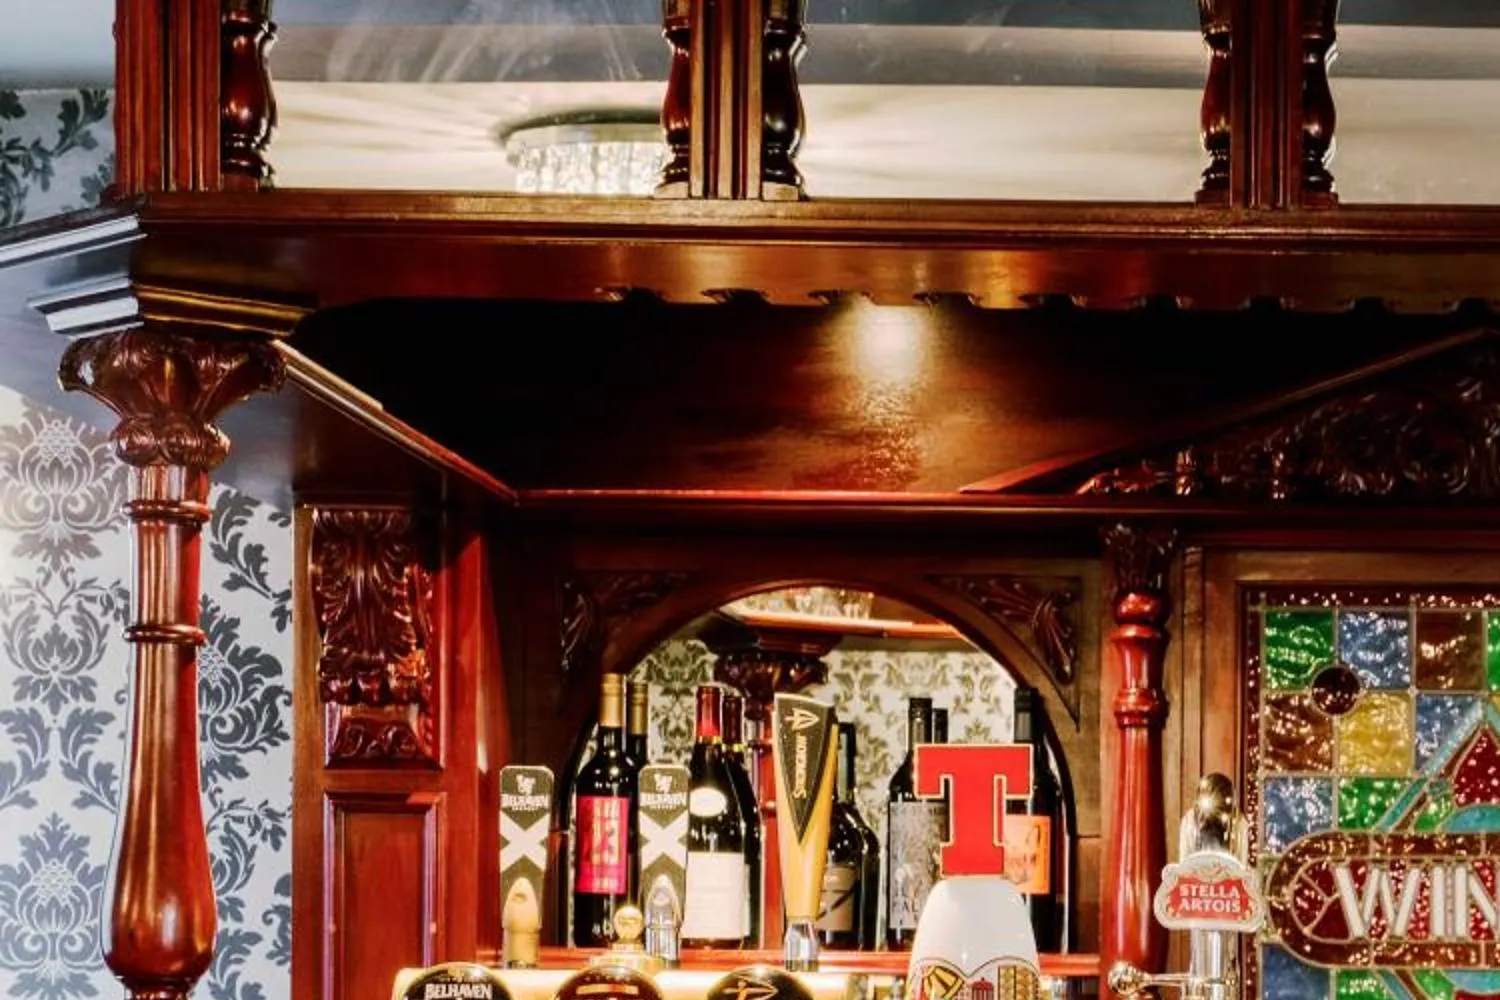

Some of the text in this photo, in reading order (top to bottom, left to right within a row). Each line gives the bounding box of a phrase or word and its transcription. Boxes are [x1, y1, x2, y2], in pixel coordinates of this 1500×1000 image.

[1179, 883, 1240, 898] STELLA
[1179, 898, 1241, 913] ARTOIS
[425, 983, 493, 1000] BELHAVEN
